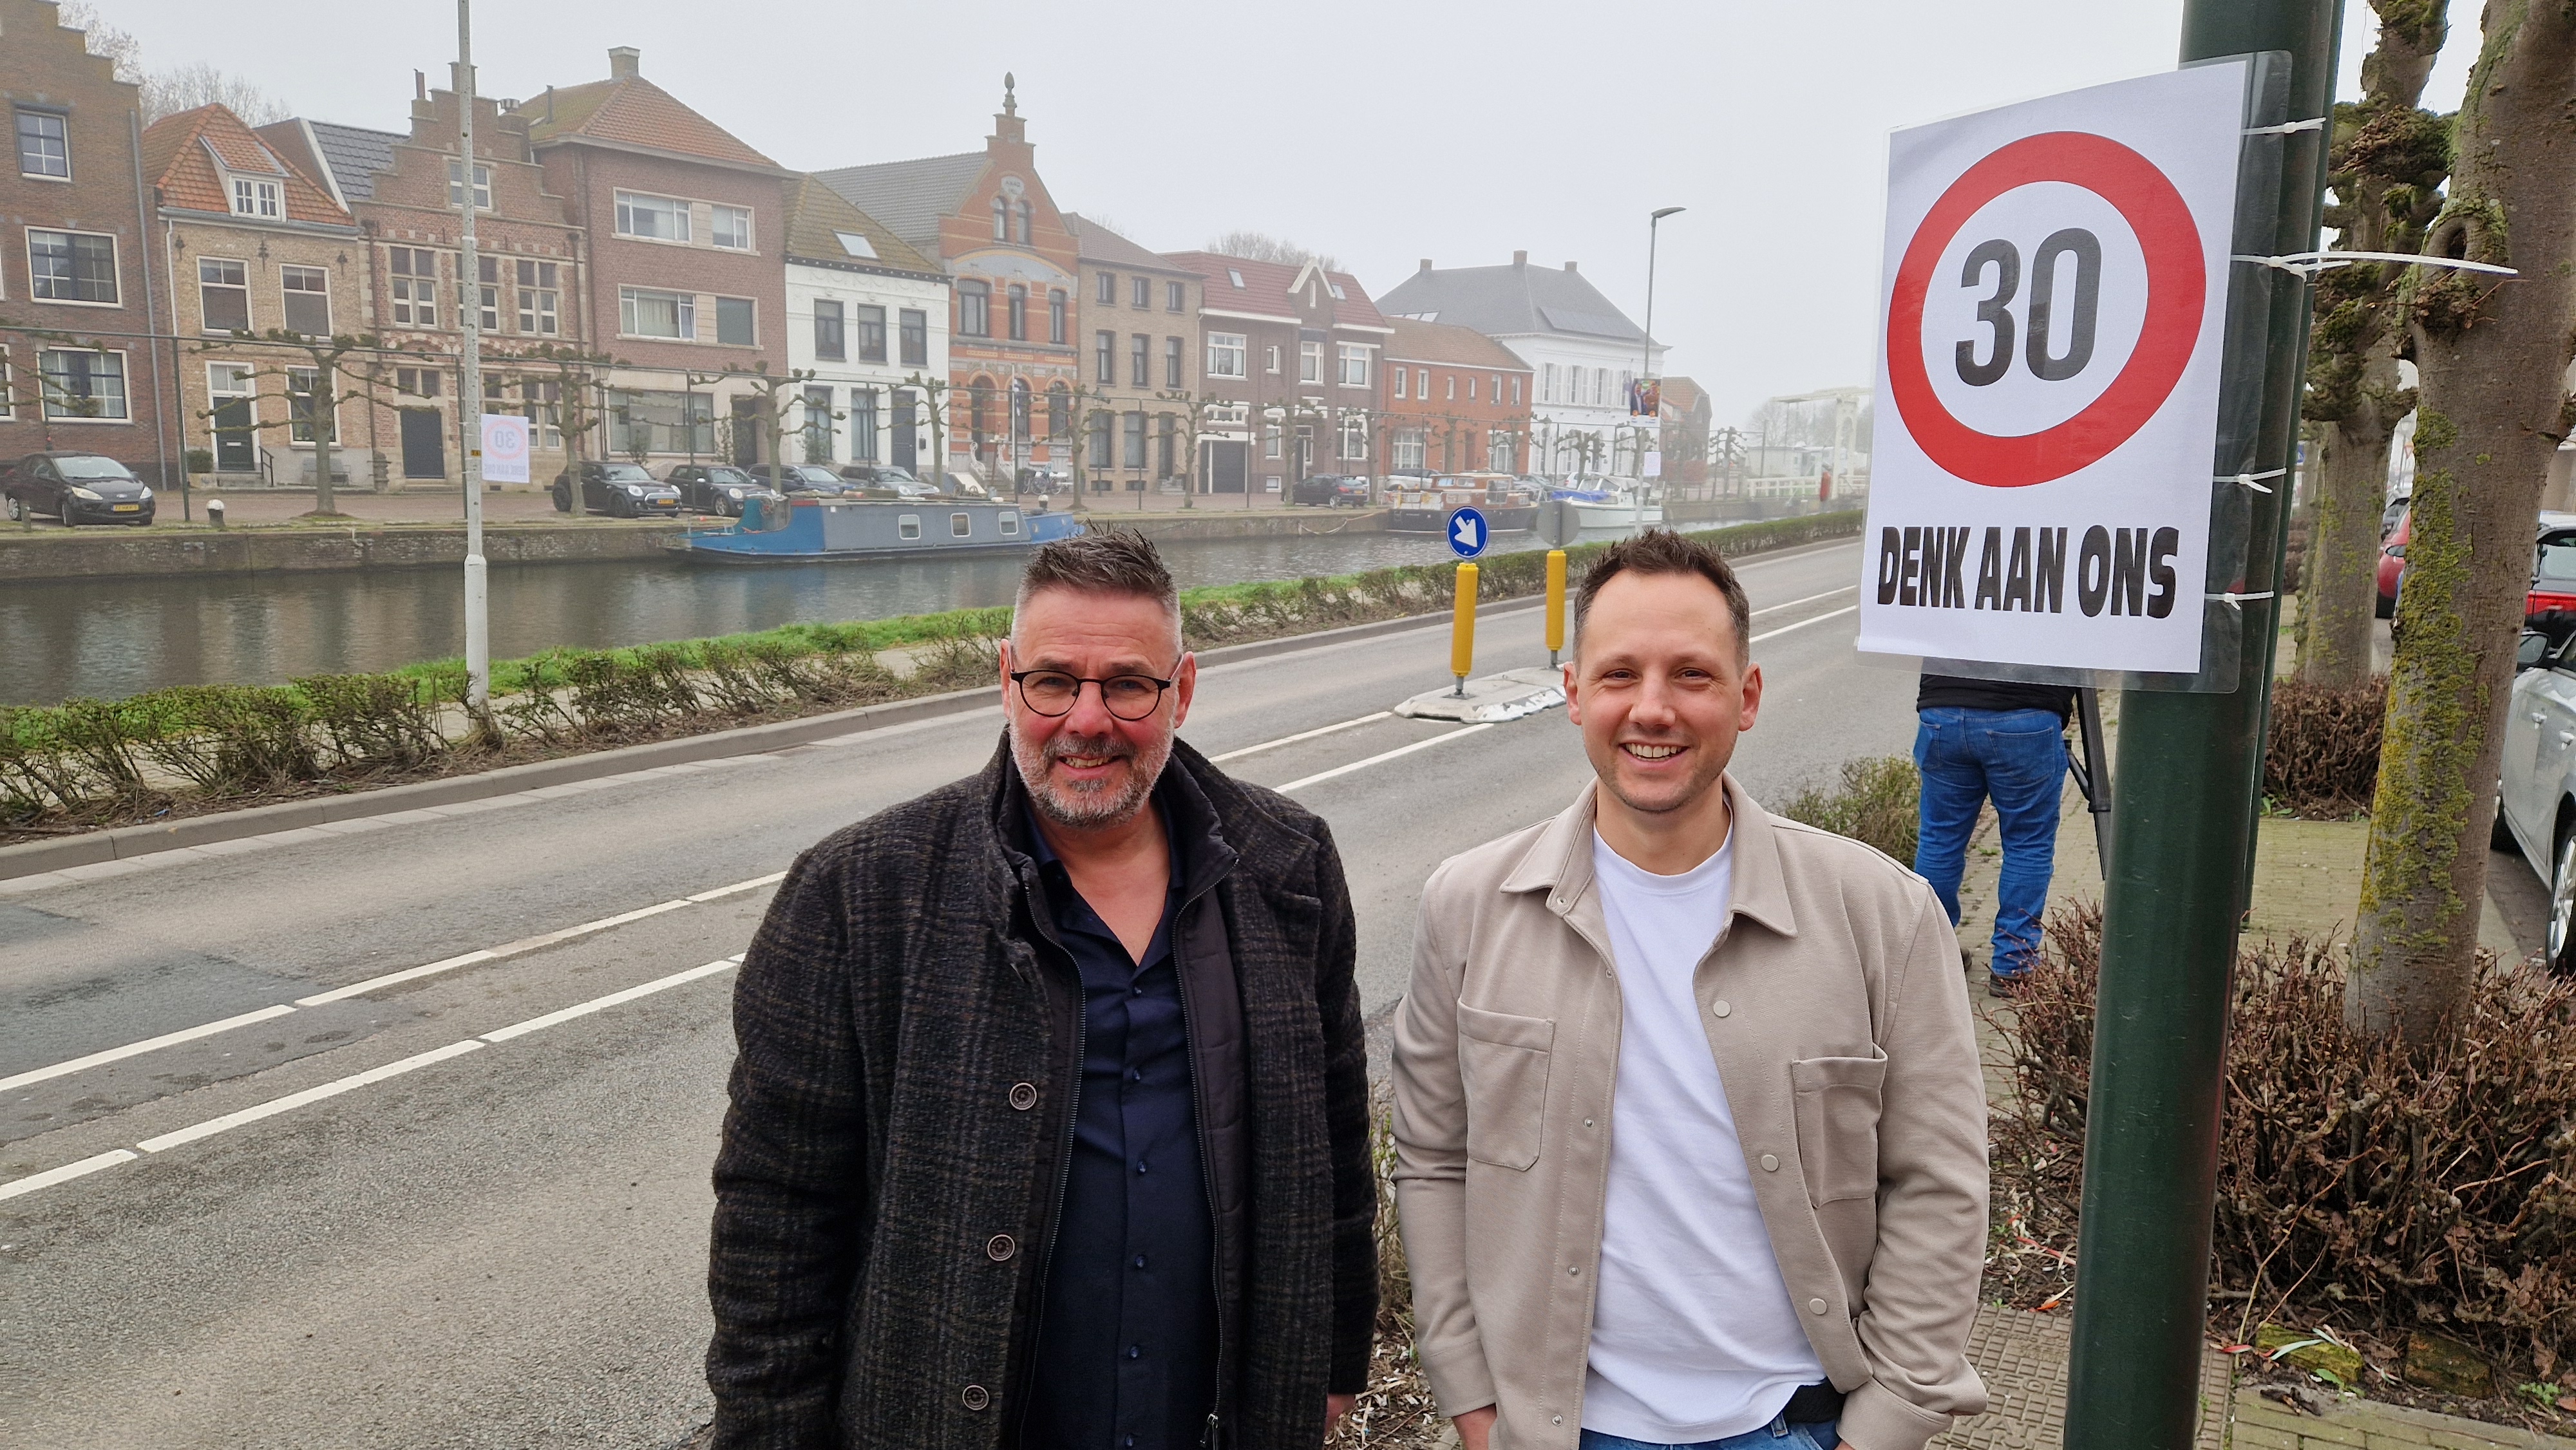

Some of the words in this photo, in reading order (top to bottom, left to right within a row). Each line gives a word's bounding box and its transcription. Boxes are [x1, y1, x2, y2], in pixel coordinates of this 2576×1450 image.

[1956, 227, 2102, 386] 30
[1877, 527, 1971, 608] DENK
[1975, 527, 2068, 614] AAN
[2078, 525, 2179, 619] ONS
[1980, 1370, 2068, 1398] REGE
[1958, 1414, 2063, 1445] WATE
